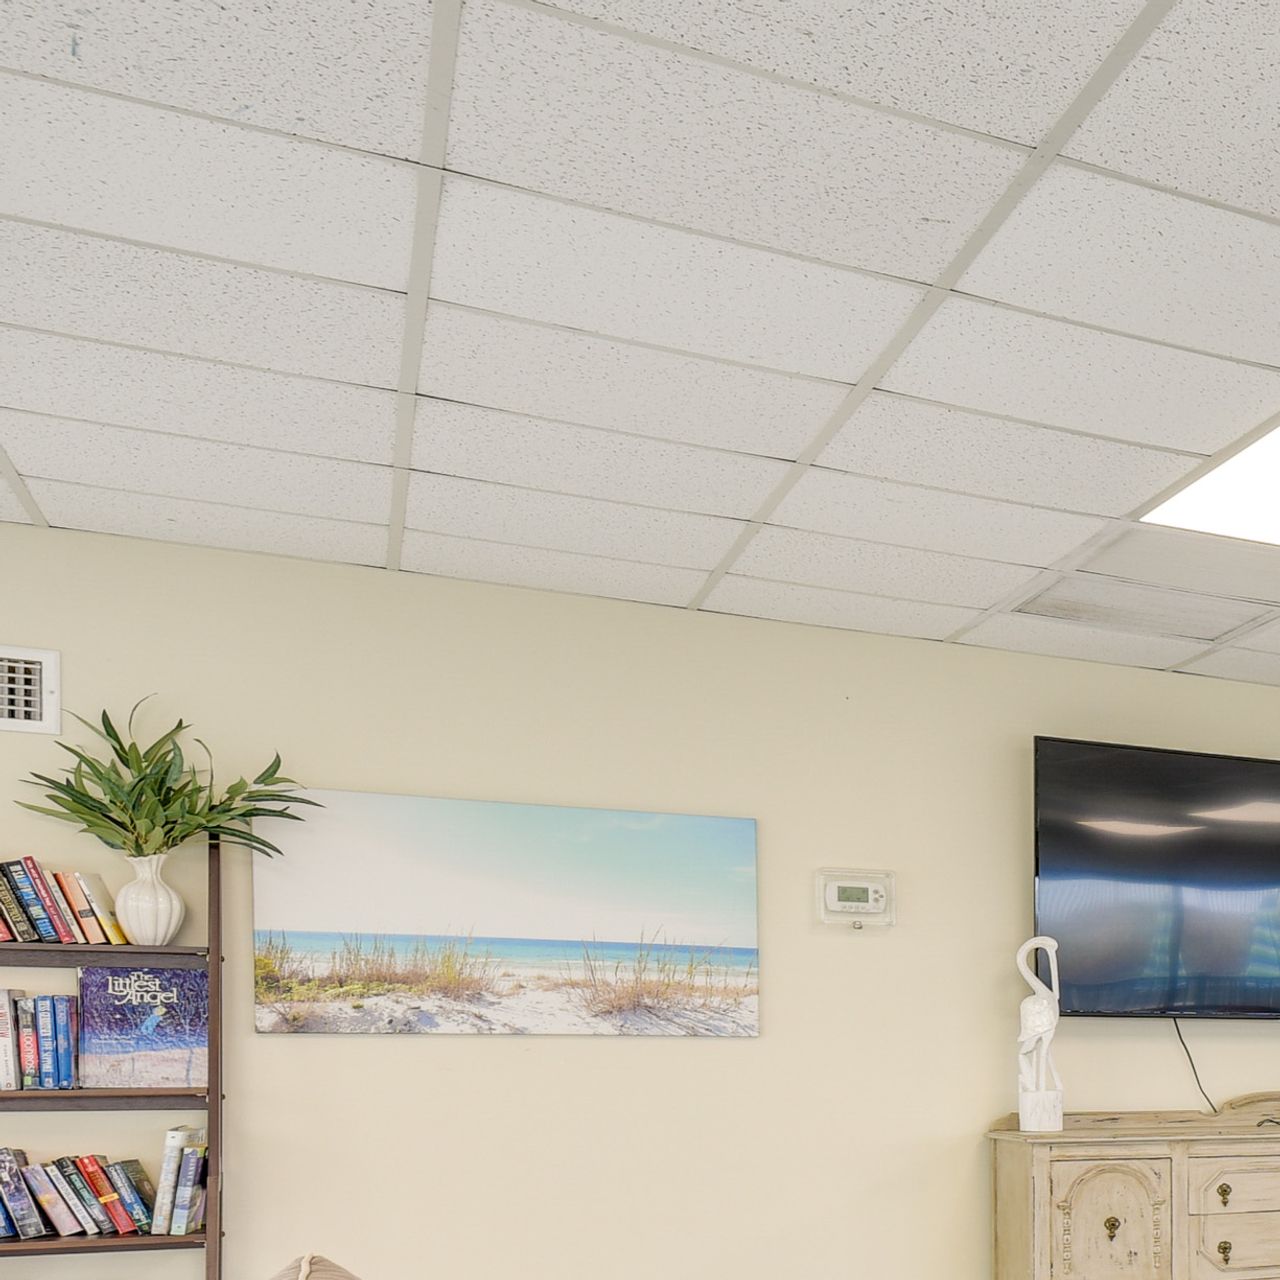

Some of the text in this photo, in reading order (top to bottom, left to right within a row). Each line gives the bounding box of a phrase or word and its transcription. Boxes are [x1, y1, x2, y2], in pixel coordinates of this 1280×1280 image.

[107, 975, 161, 996] Littlest
[131, 971, 153, 981] The
[115, 987, 179, 1006] Angel
